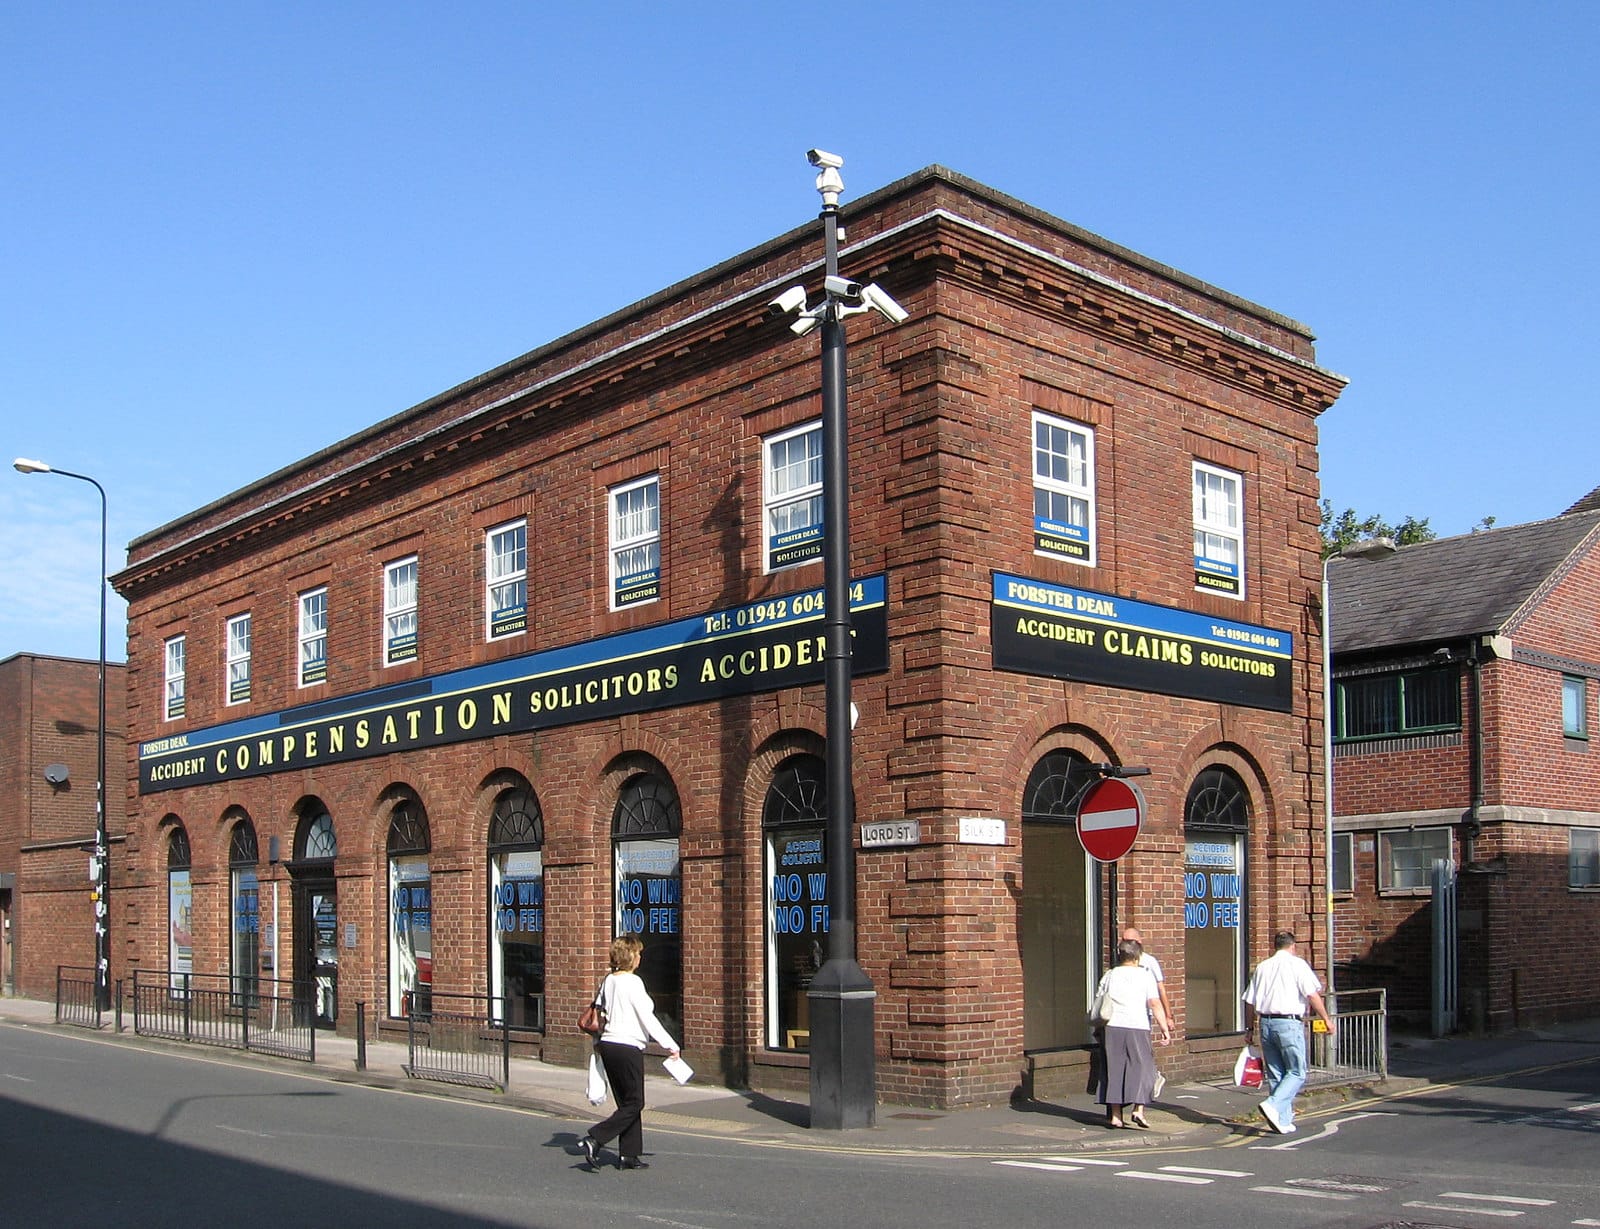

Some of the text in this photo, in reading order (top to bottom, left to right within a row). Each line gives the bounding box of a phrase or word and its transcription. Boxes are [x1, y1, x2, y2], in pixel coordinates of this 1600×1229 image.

[776, 546, 821, 563] SOLICITORS
[1040, 538, 1083, 556] SOLICITORS
[620, 586, 657, 602] SOLICITORS
[1198, 575, 1234, 590] SOLICITORS
[1008, 581, 1118, 618] FORSTER DEAN.
[704, 615, 732, 635] Tel:
[736, 600, 786, 627] 01942
[792, 591, 825, 615] 604
[495, 620, 526, 633] SOLICITORS
[1211, 625, 1226, 639] Tel:
[1227, 628, 1250, 643] 01942
[1250, 632, 1265, 646] 604
[1015, 617, 1276, 678] ACCIDENT CLAIMS SOLICITORS
[150, 757, 206, 782] ACCIDENT
[216, 691, 513, 775] COMPENSATION
[530, 665, 679, 714] SOLICITORS
[143, 739, 170, 755] FORSTER
[865, 827, 893, 841] LORD
[964, 824, 984, 837] SILK
[620, 878, 681, 905] NO WIN
[773, 873, 803, 902] NO
[1184, 871, 1241, 899] NO WIN
[496, 908, 516, 933] NO
[621, 907, 678, 933] NO FEE
[775, 905, 805, 934] NO
[1184, 901, 1240, 929] NO FEE
